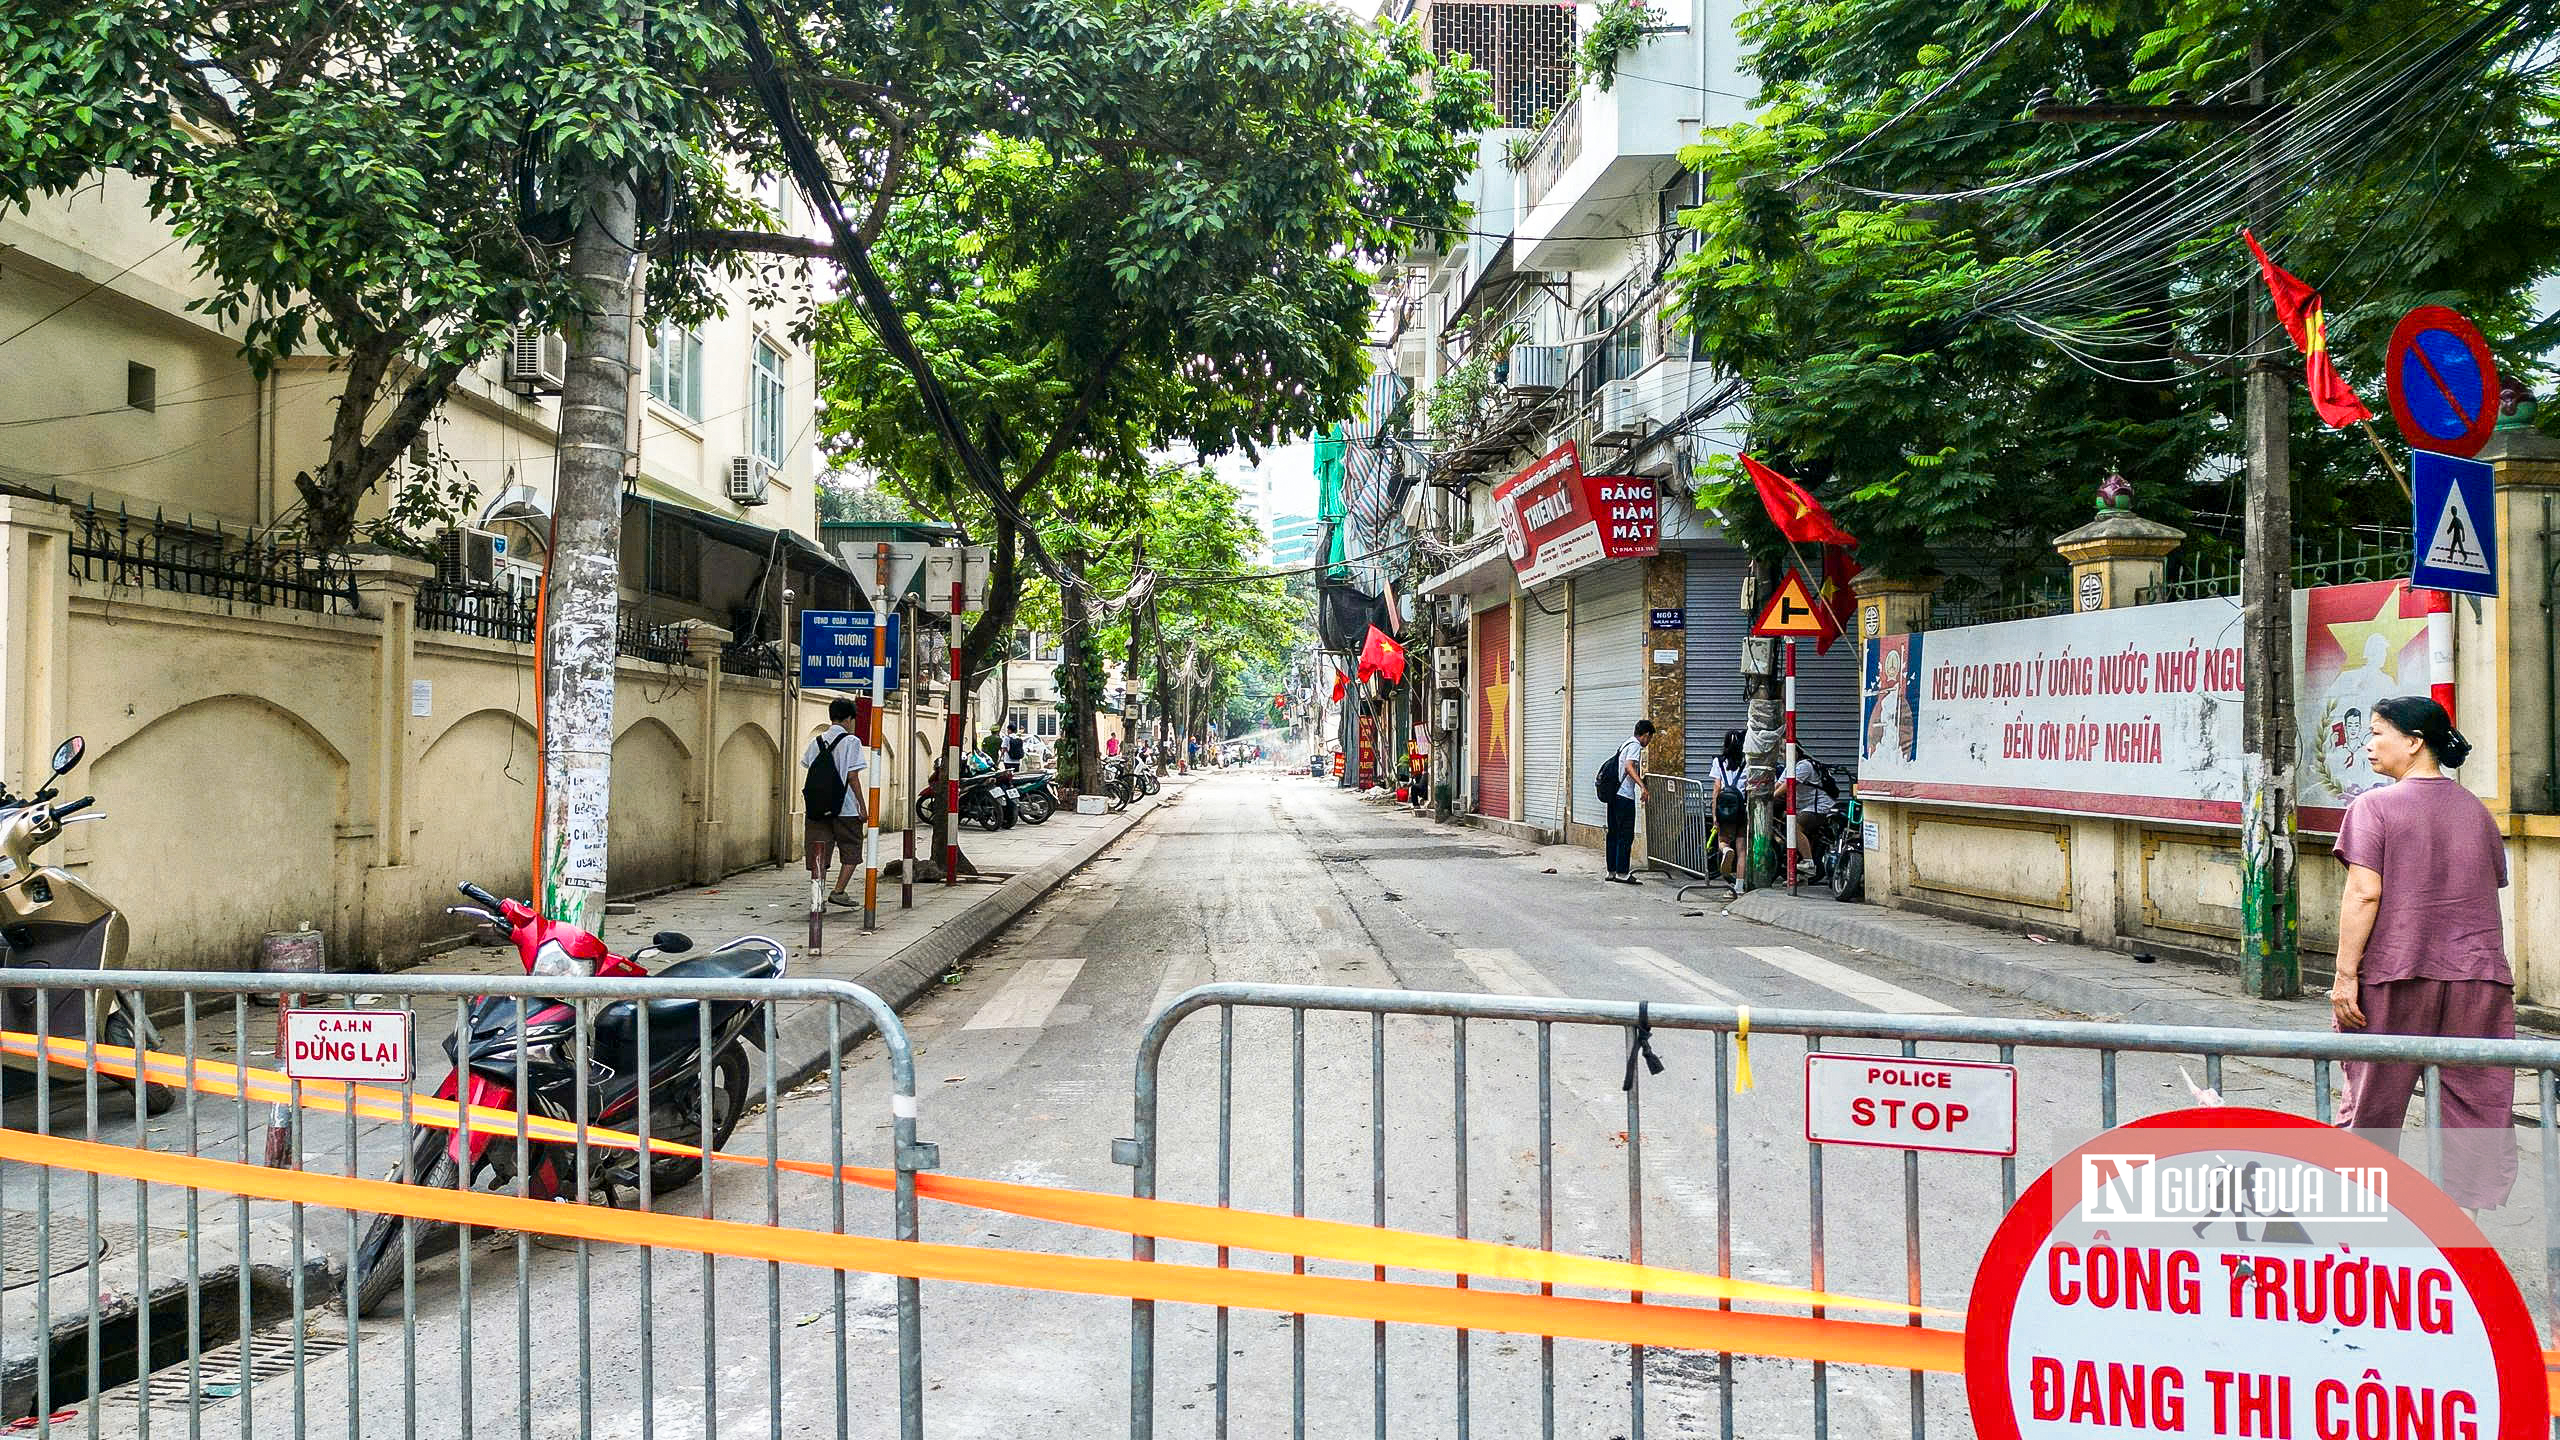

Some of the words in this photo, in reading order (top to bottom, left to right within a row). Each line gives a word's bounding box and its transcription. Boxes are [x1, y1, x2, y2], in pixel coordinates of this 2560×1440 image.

[1601, 483, 1653, 500] RĂNG
[1612, 503, 1653, 520] HÀM
[1613, 522, 1654, 542] MẶT
[834, 632, 867, 646] TRƯỜNG
[808, 655, 822, 667] MN
[1931, 659, 1958, 701] NÊU
[1961, 664, 1989, 699] CAO
[1992, 661, 2022, 706] ĐẠO
[2026, 652, 2044, 697] LÝ
[2048, 644, 2093, 697] UỐNG
[2098, 642, 2149, 695] NƯỚC
[2154, 637, 2200, 693] NHỚ
[2003, 710, 2034, 759] ĐỀN
[2038, 720, 2060, 760] ƠN
[2065, 715, 2100, 761] ĐÁP
[2104, 715, 2163, 764] NGHĨA
[319, 1020, 372, 1032] C.A.H.N
[295, 1034, 355, 1061] DỪNG
[361, 1042, 398, 1067] LẠI
[1868, 1068, 1952, 1088] POLICE
[1851, 1097, 1969, 1132] STOP
[2048, 1230, 2201, 1315] CÔNG
[2221, 1242, 2454, 1334] TRƯỜNG
[2030, 1356, 2185, 1432] ĐANG
[2205, 1369, 2291, 1440] THI
[2315, 1368, 2478, 1440] CÔNG
